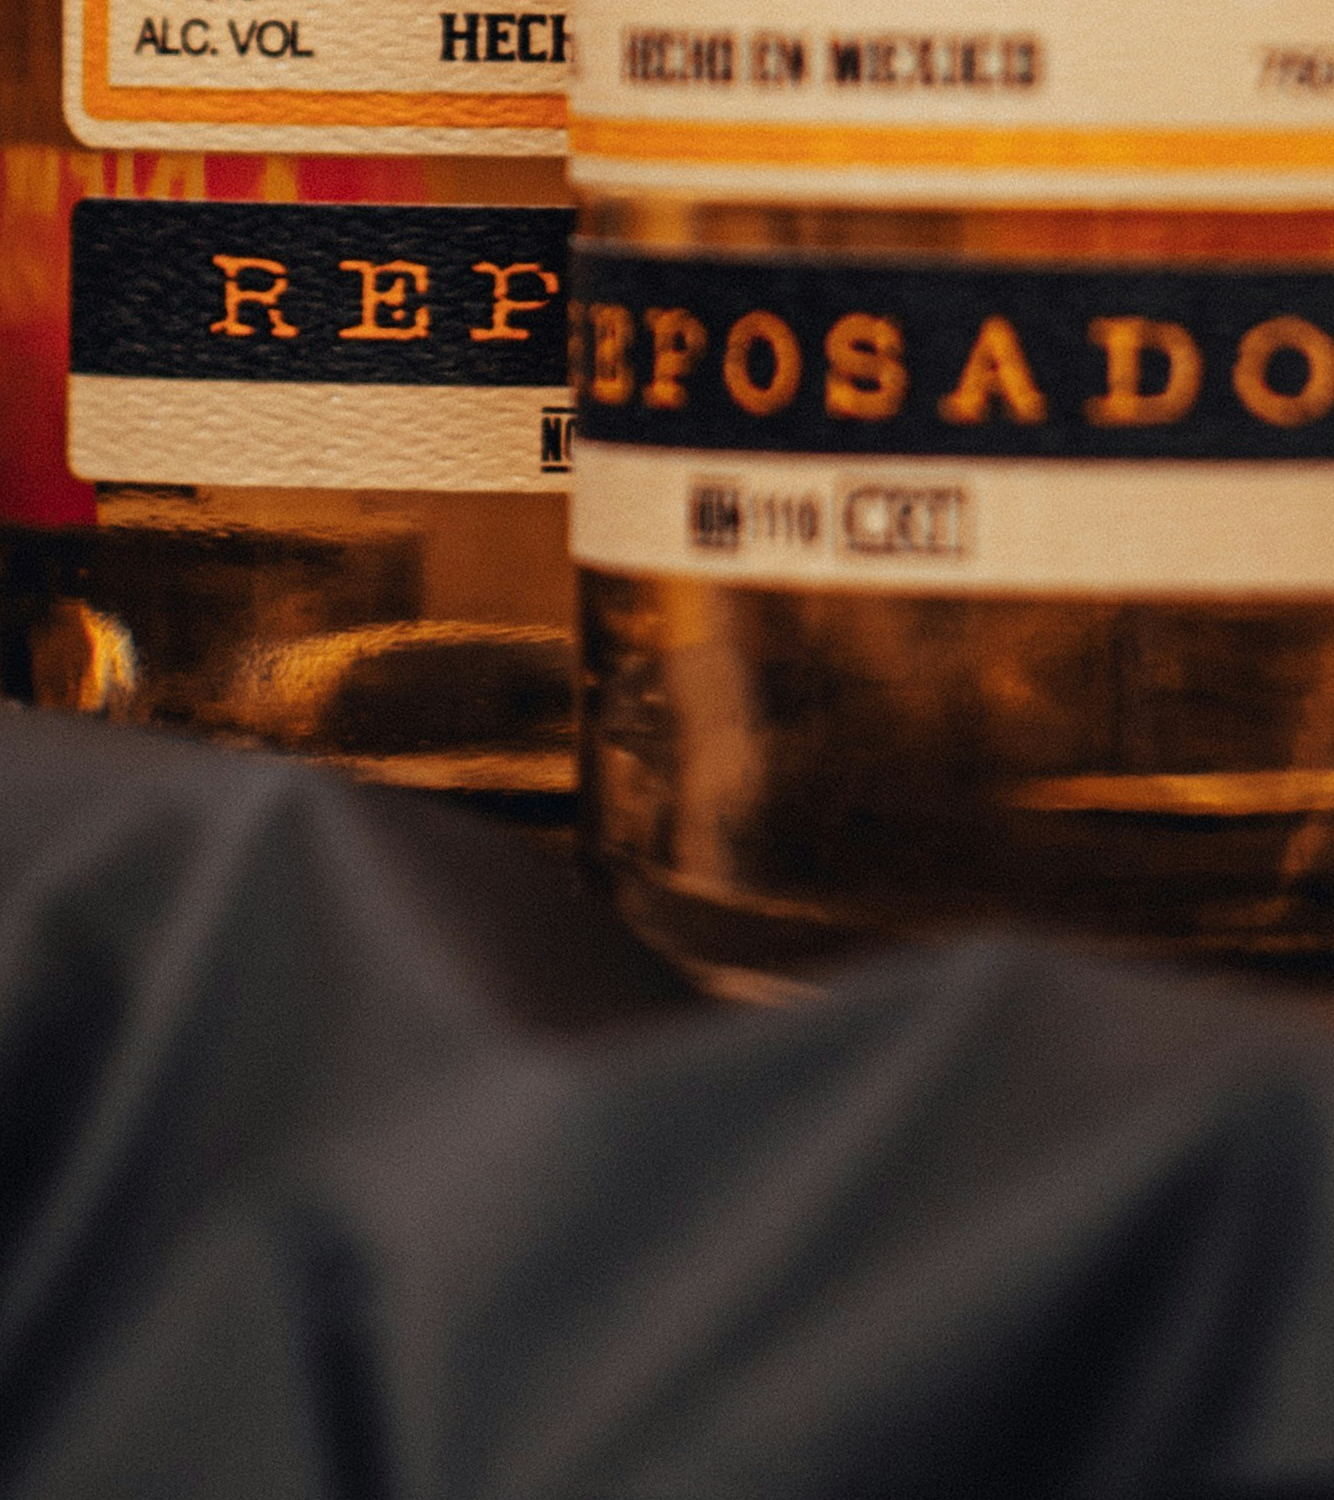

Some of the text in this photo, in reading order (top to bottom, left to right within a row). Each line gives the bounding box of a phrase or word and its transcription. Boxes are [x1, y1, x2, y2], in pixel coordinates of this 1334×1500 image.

[134, 16, 315, 59] ALC. VOL
[827, 30, 1043, 90] MEXICO
